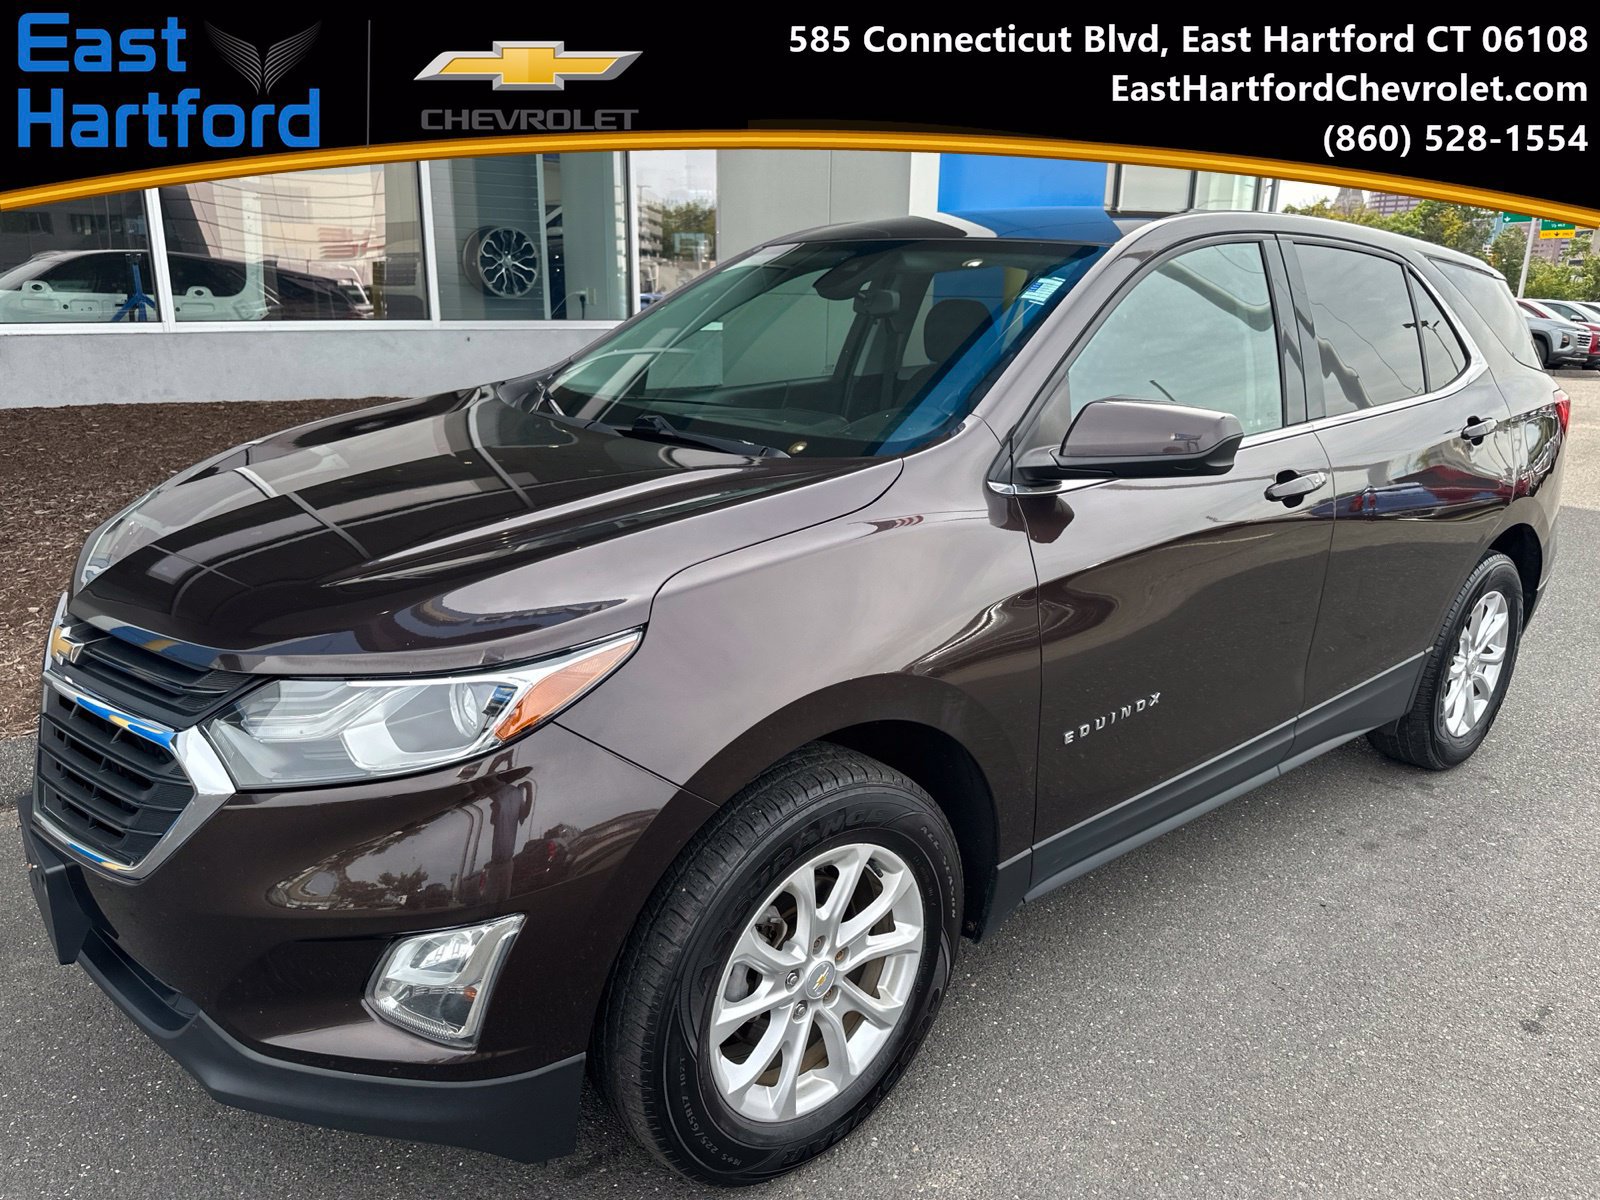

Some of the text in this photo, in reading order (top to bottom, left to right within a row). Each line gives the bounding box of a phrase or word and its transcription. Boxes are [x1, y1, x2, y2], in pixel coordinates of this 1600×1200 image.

[1063, 692, 1161, 745] EQUINOX
[700, 806, 890, 997] ASSURANCE
[677, 1057, 687, 1087] 102T
[681, 1095, 719, 1154] 225/65R17
